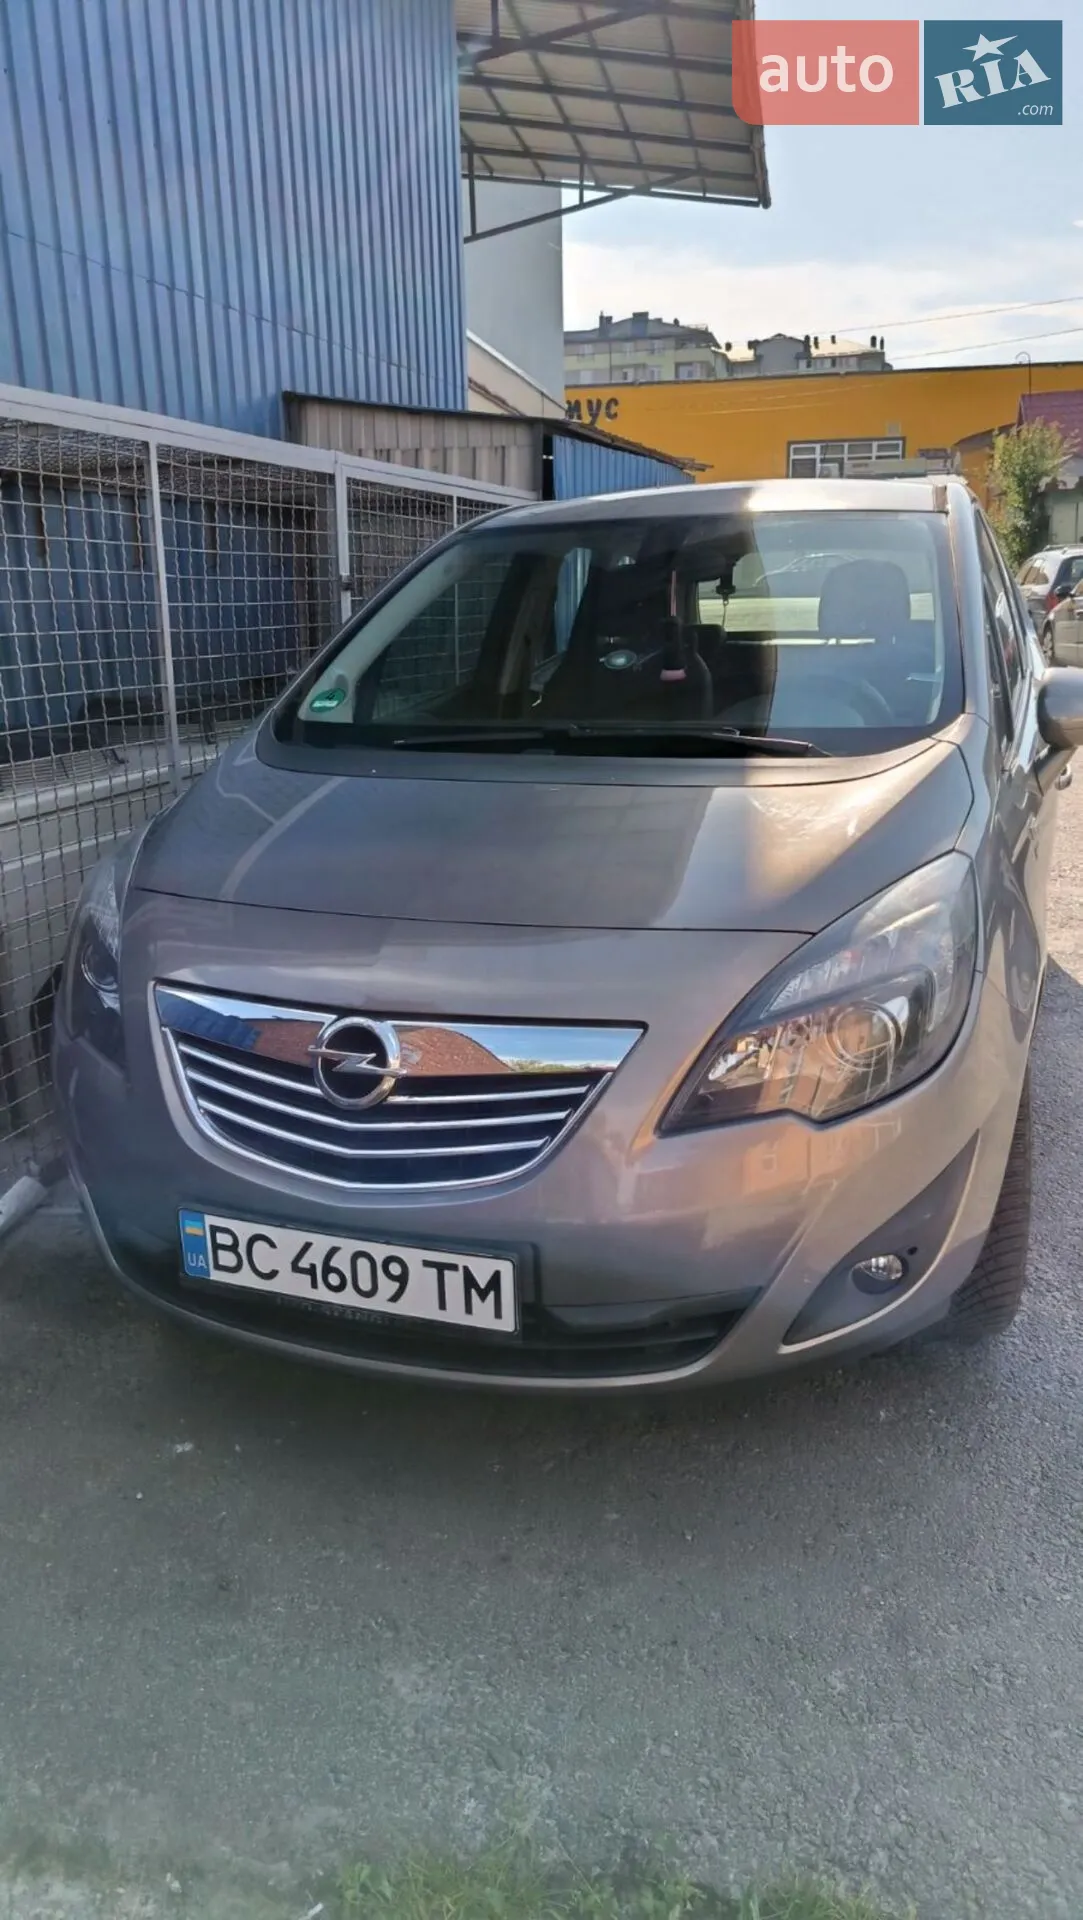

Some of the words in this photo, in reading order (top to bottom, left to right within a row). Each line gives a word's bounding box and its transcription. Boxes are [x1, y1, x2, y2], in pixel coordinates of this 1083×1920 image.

[186, 1251, 208, 1269] UA
[208, 1224, 279, 1281] BC
[290, 1241, 410, 1303] 4609
[422, 1258, 503, 1320] TM
